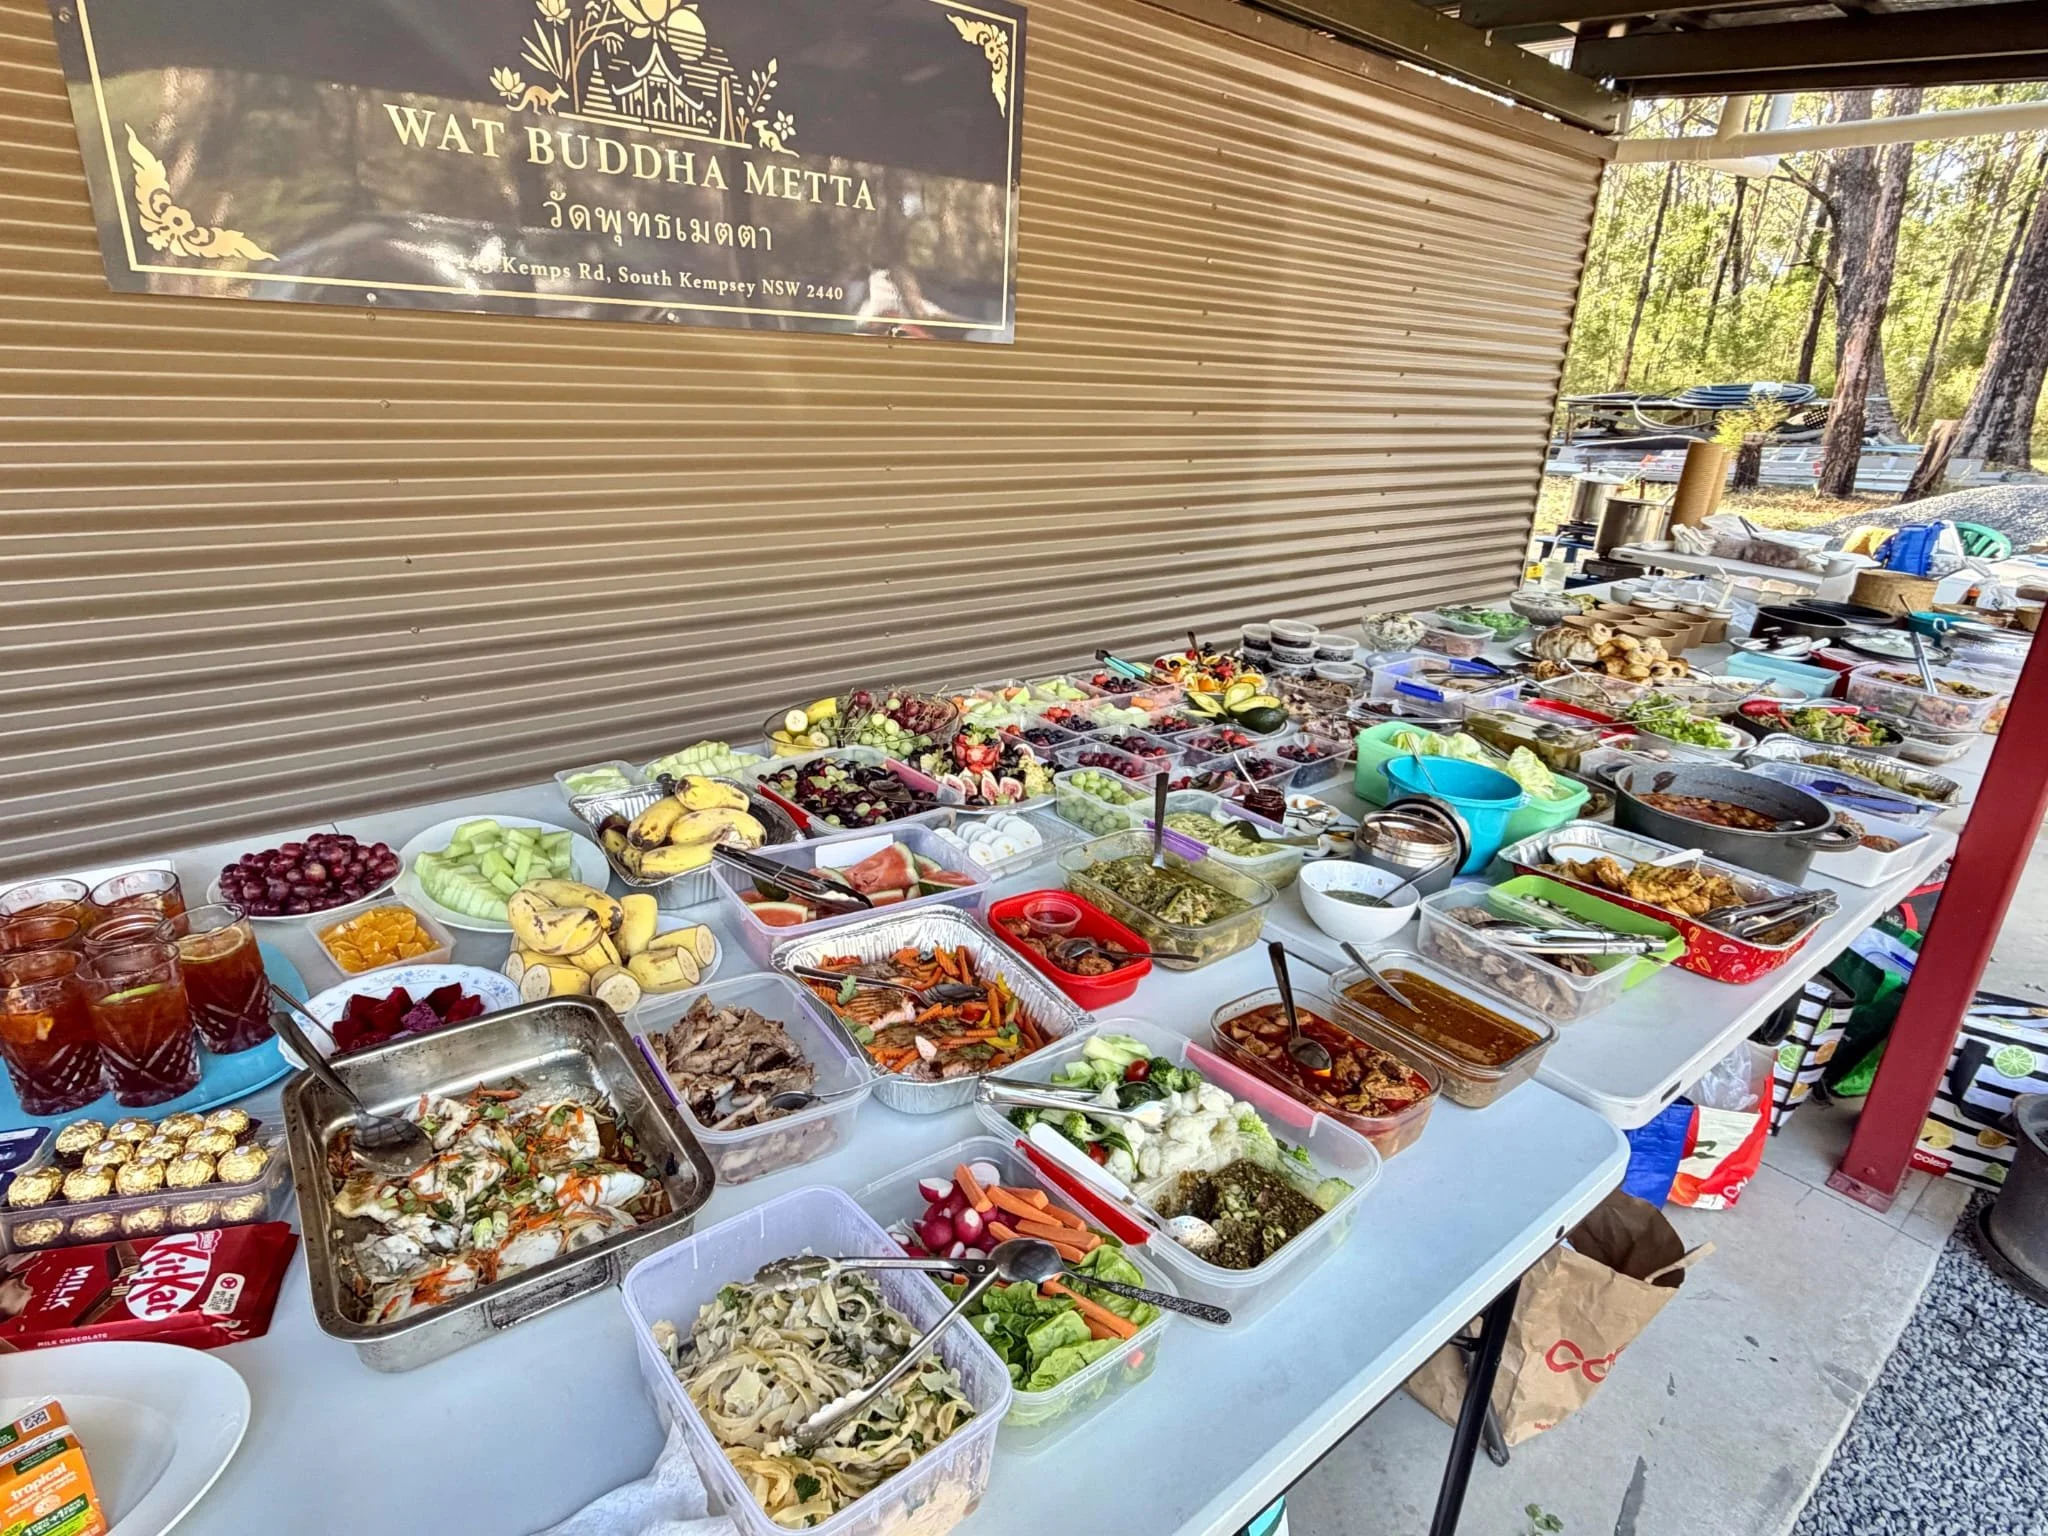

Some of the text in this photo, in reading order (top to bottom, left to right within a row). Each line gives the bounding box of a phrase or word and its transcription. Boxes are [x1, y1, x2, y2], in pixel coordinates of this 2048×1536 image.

[382, 103, 877, 211] WAT BUDDHA METTA
[543, 190, 773, 250] วัดพุทธเมตตา
[502, 256, 571, 281] Kemps
[577, 262, 612, 284] Rd,
[618, 266, 673, 286] South
[679, 271, 756, 297] Kempsey
[762, 279, 801, 297] NSW
[807, 285, 844, 300] 2440
[1913, 1152, 1948, 1169] coles
[49, 1265, 95, 1311] MILK
[128, 1240, 210, 1317] KitKat
[37, 1332, 108, 1348] MILK CHOCOLATE
[10, 1461, 68, 1501] tropical
